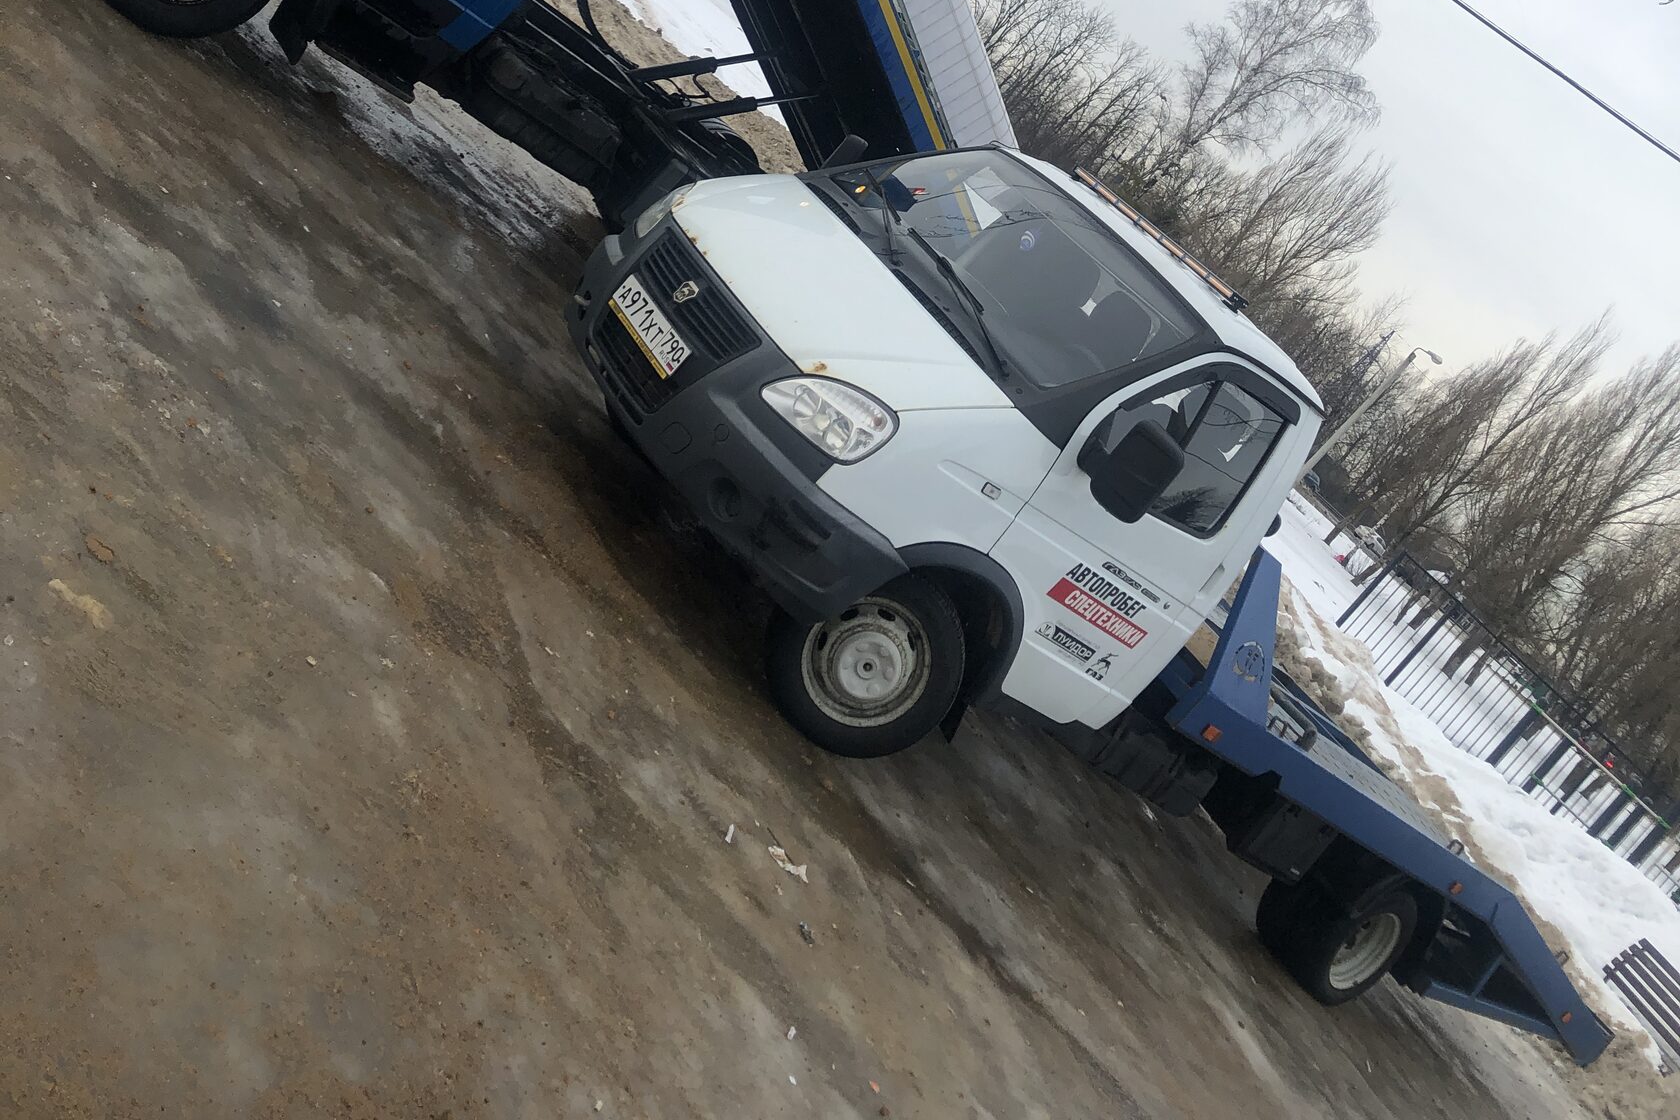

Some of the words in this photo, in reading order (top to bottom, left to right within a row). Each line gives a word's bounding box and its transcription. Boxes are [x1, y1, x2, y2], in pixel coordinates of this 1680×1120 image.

[659, 350, 670, 364] RUS
[661, 332, 685, 364] 790
[1065, 562, 1147, 619] АВТОПРОБЕГ
[1064, 590, 1144, 647] СПЕЦТЕХНИКИ
[1085, 667, 1104, 681] ГАЗ
